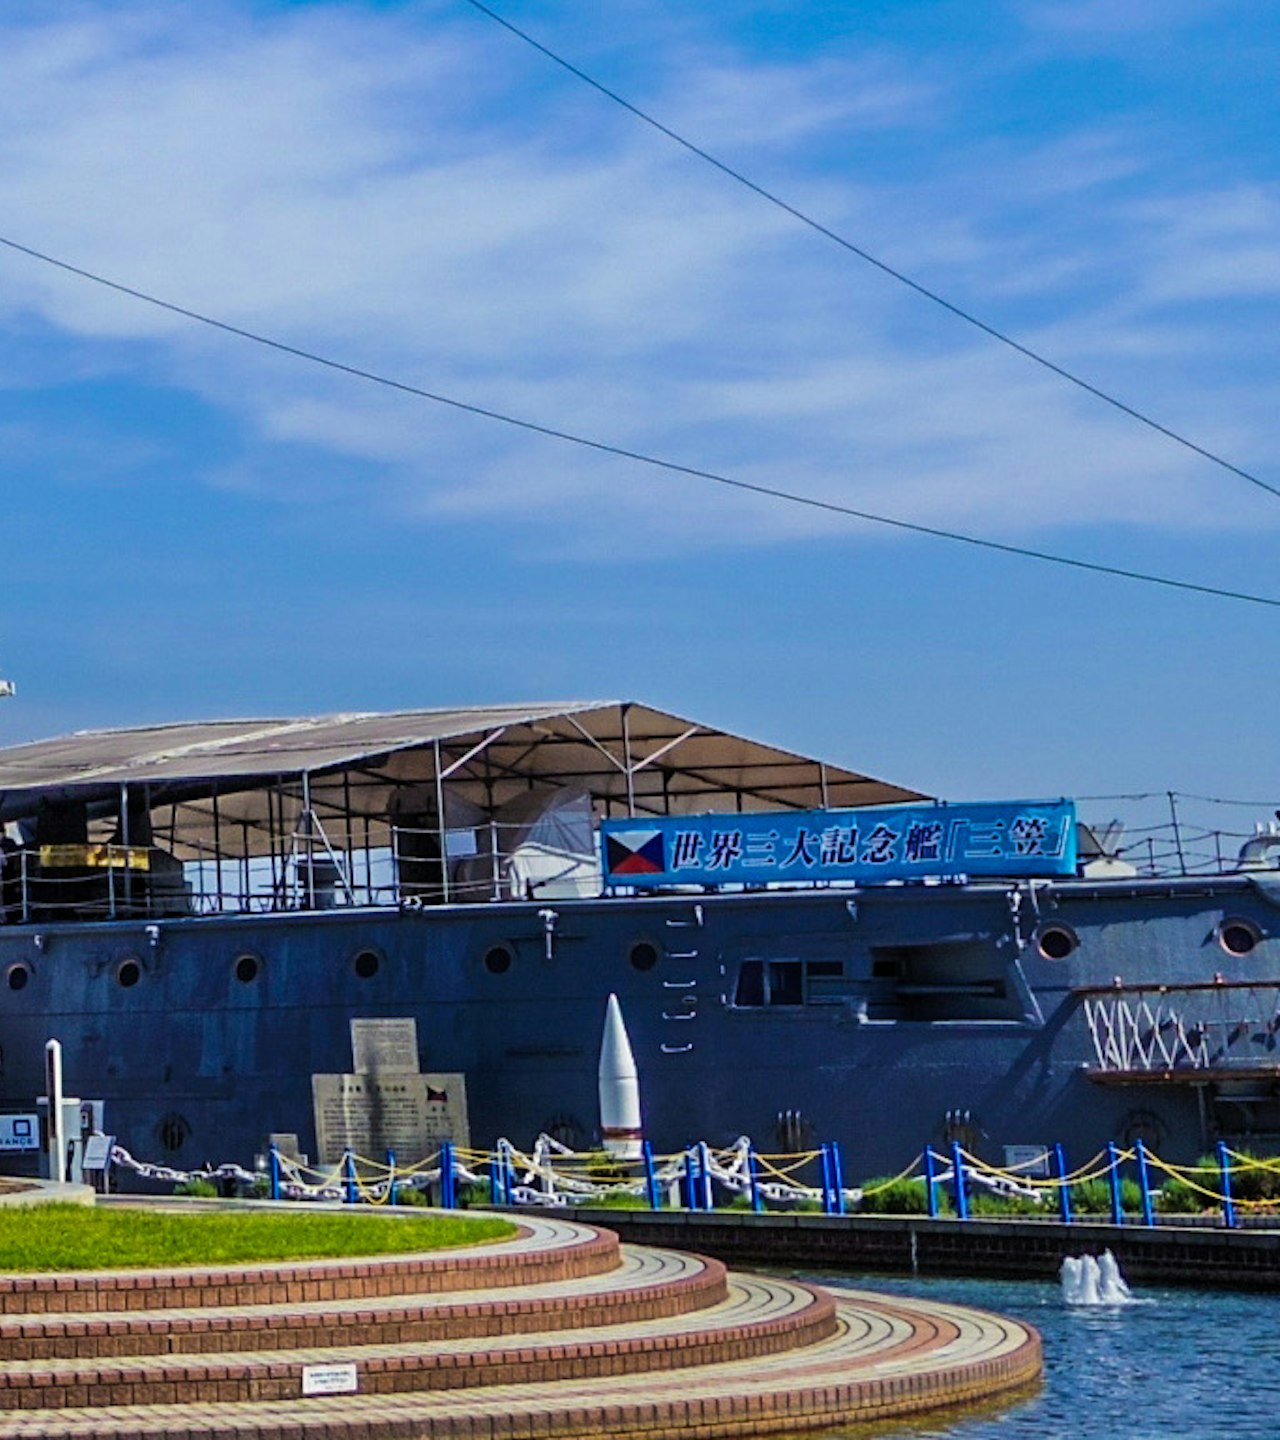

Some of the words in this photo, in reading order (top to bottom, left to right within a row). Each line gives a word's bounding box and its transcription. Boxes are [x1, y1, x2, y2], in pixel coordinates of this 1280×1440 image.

[669, 814, 1072, 872] 世界三大記念艦「三笠」
